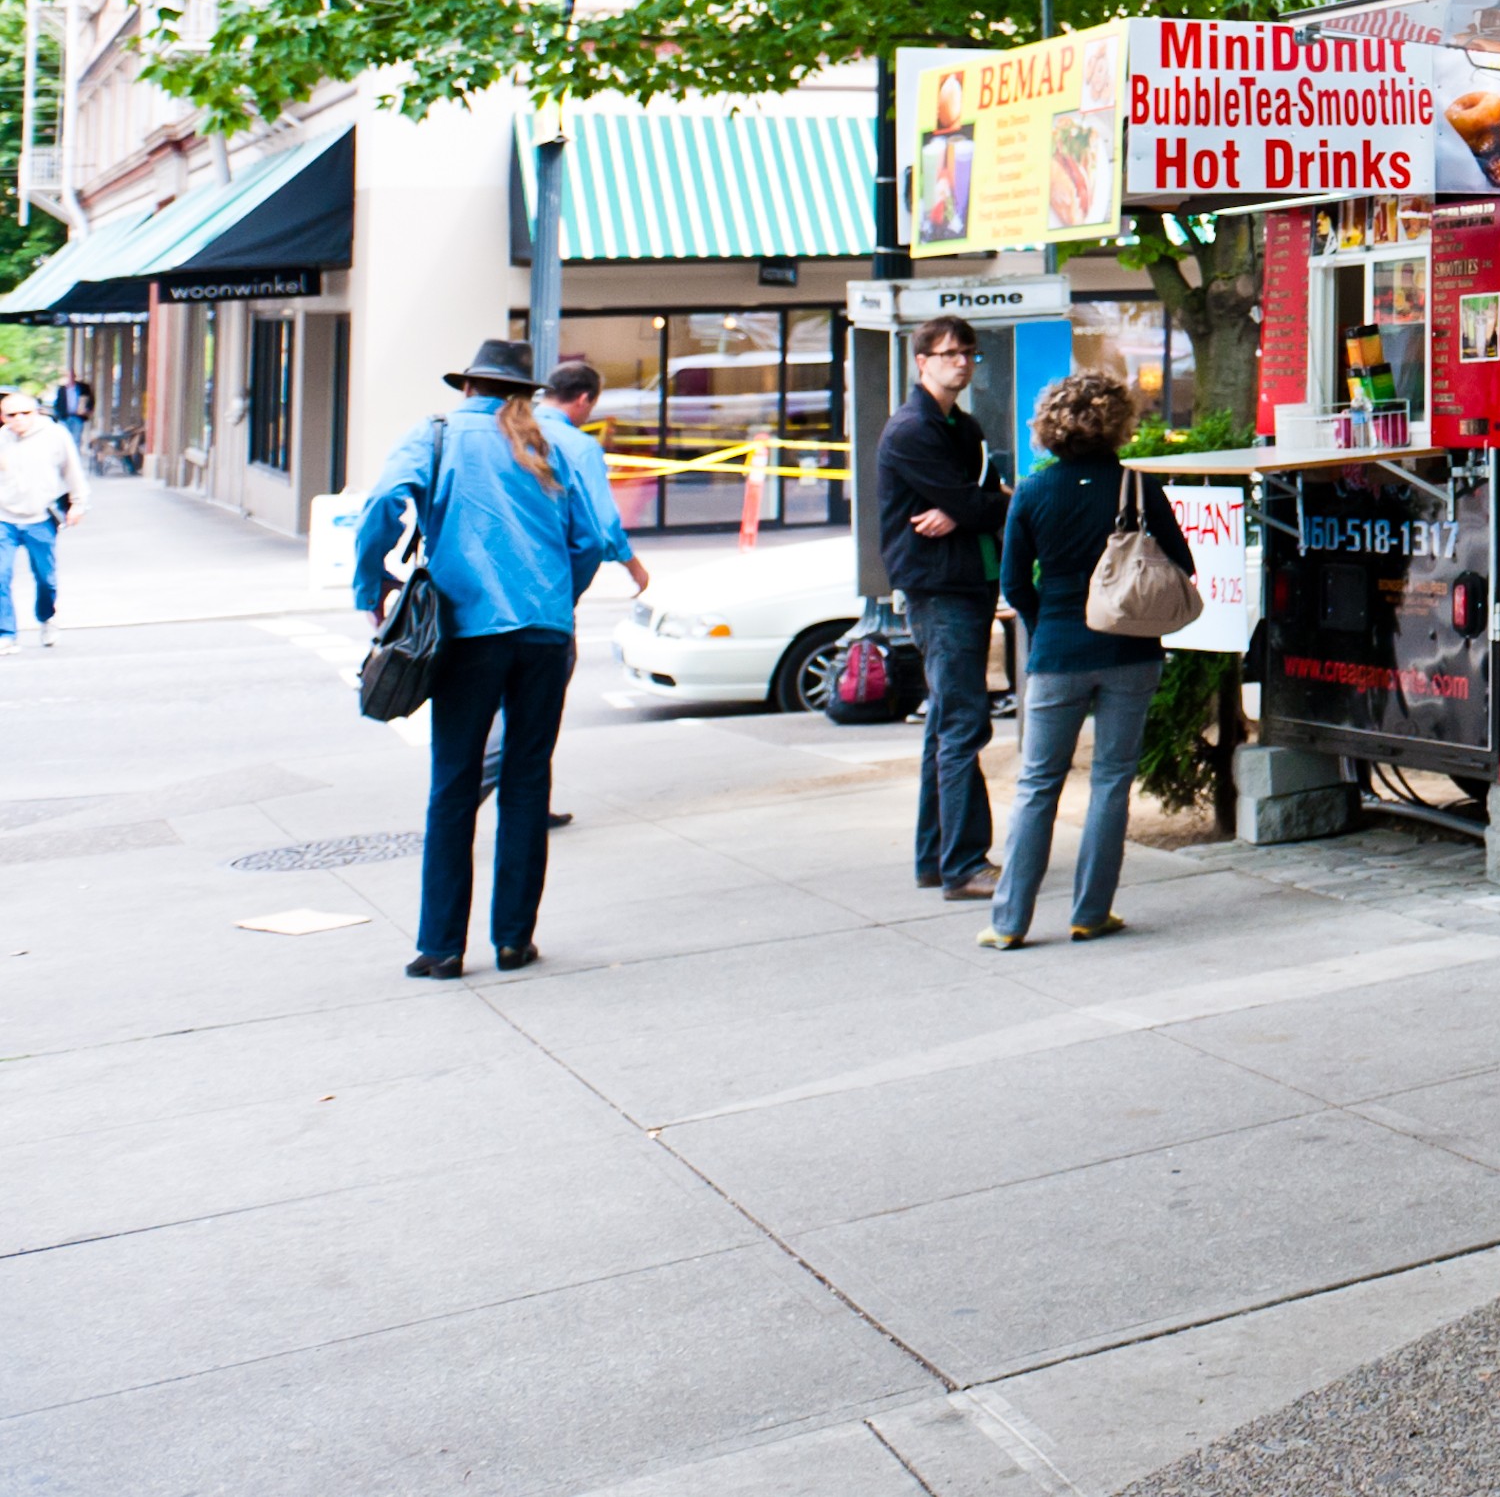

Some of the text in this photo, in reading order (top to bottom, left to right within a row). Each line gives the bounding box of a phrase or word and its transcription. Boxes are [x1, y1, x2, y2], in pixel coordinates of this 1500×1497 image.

[978, 46, 1075, 110] BEMAP
[1131, 74, 1434, 127] BubbleTea-Smoothie
[1155, 138, 1412, 190] Hot Drinks
[170, 275, 307, 300] woonwinkel
[939, 291, 1023, 307] Phone
